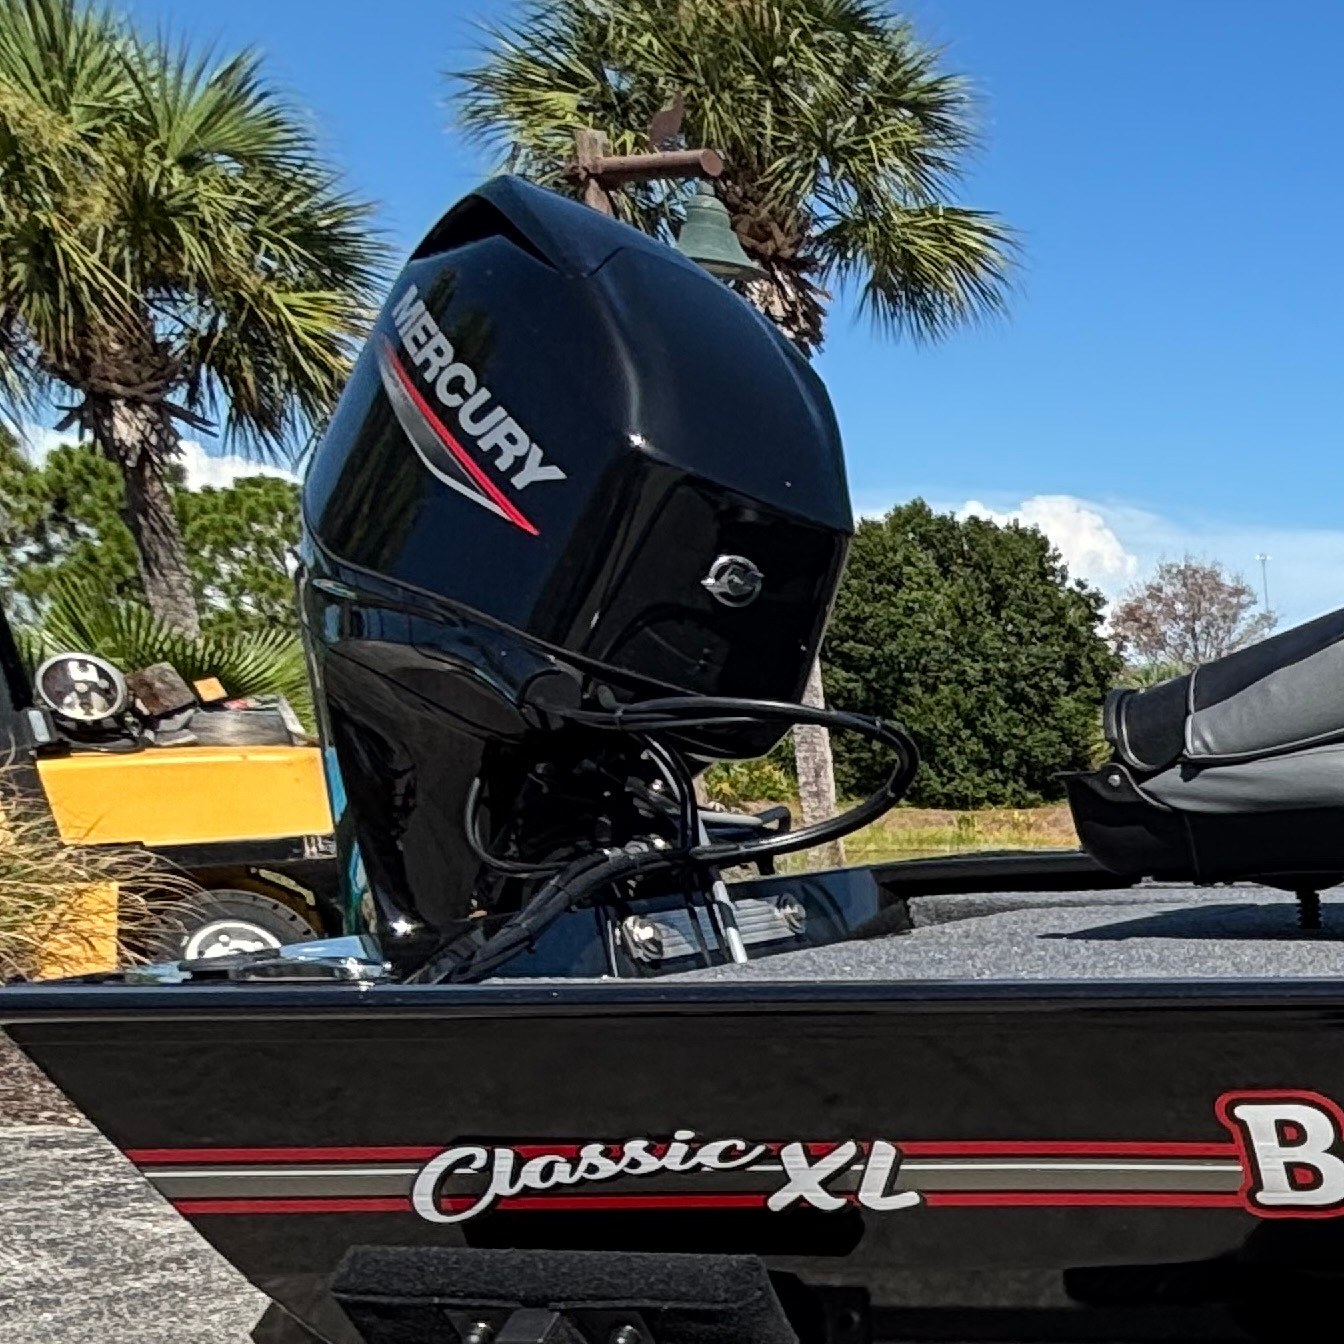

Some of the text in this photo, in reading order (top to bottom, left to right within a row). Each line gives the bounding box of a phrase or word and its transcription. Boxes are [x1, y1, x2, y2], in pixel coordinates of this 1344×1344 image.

[391, 284, 567, 491] MERCURY
[411, 1130, 920, 1223] Classic XL
